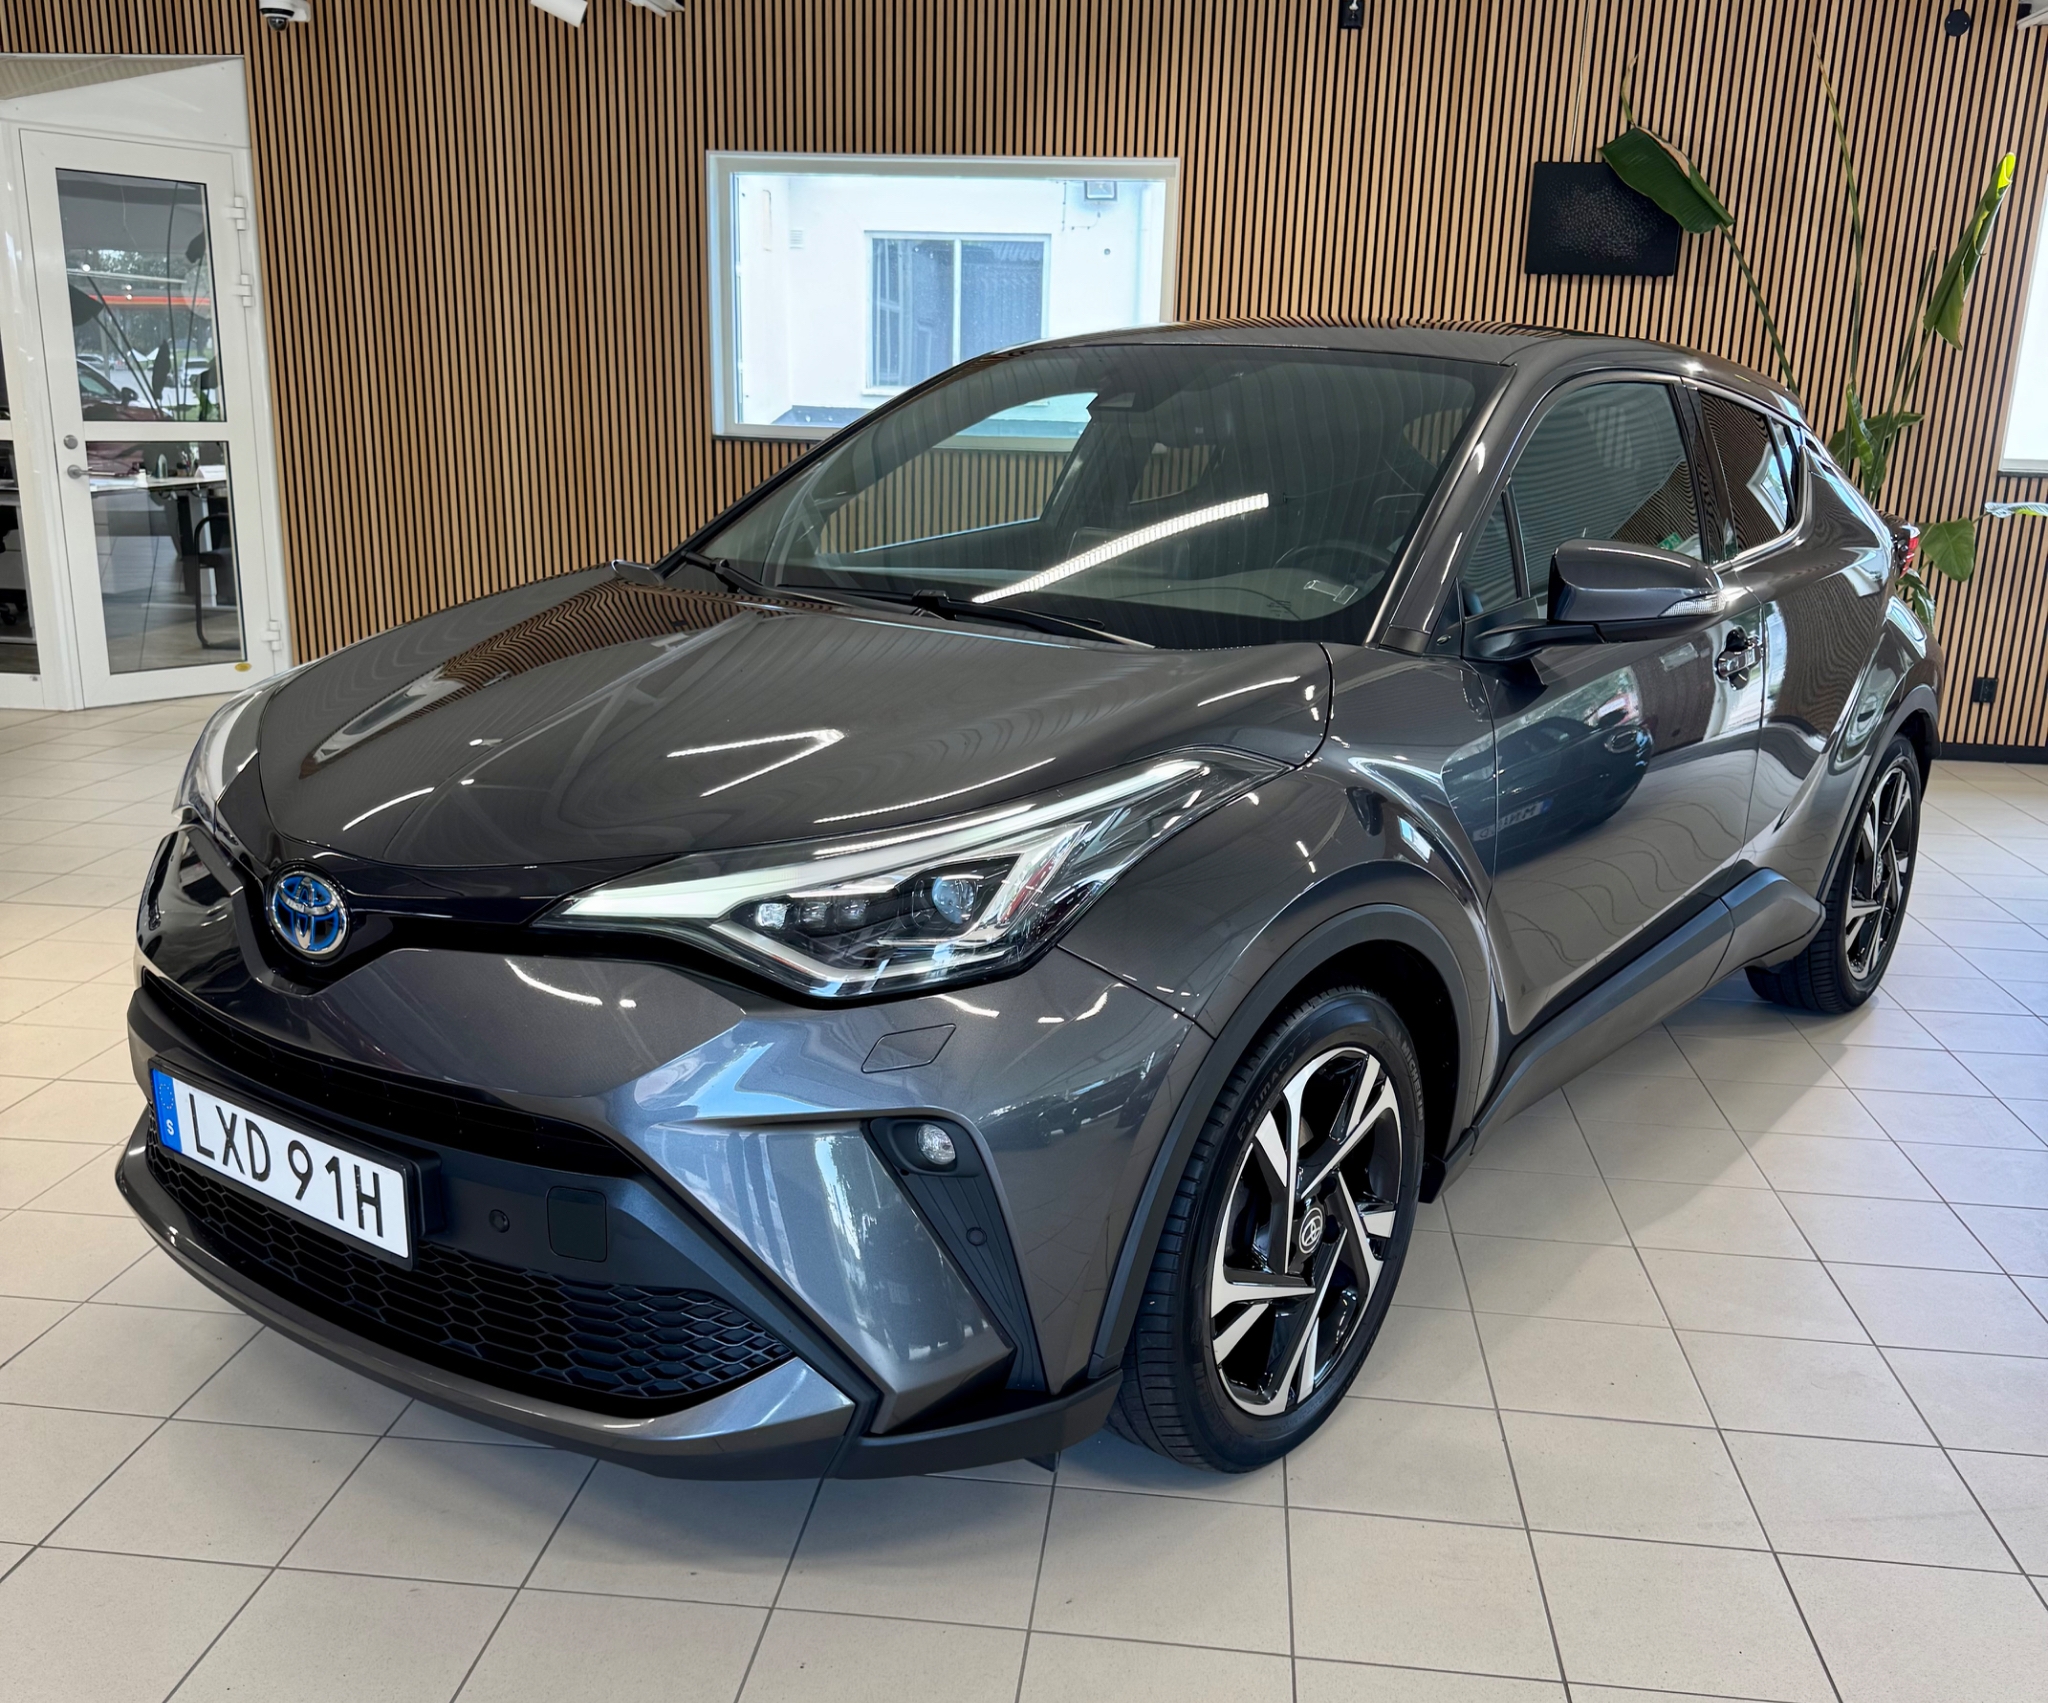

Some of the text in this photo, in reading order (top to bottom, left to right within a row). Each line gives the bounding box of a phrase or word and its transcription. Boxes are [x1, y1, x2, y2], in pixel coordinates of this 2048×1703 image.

[1237, 1046, 1297, 1141] PRIMACY
[1401, 1040, 1424, 1122] MICHELIN
[165, 1118, 175, 1137] S
[188, 1092, 384, 1239] LXD 91H
